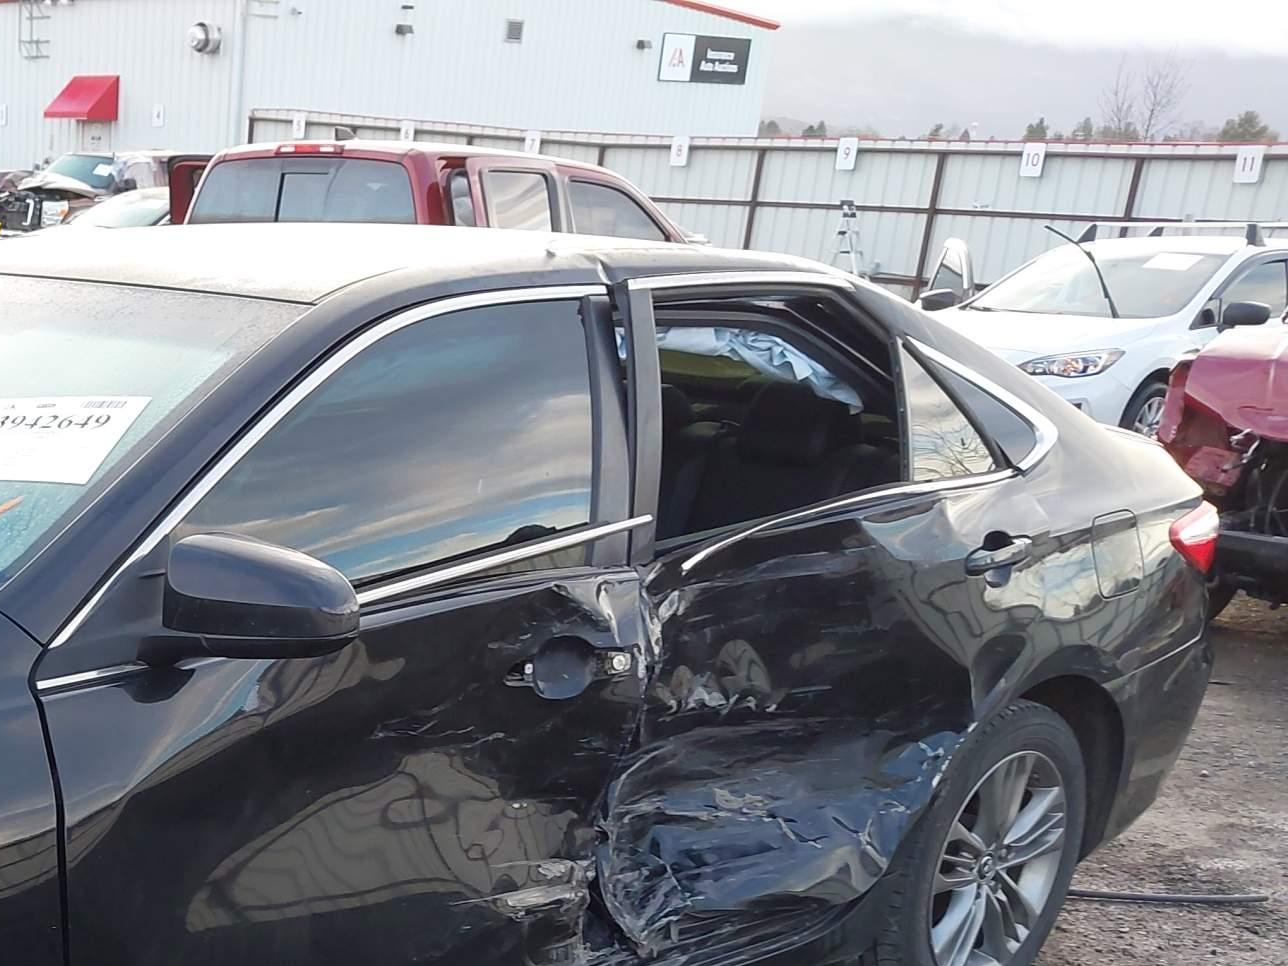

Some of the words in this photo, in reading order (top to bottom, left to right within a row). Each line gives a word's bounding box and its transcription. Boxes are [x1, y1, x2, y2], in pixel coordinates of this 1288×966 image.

[843, 146, 851, 160] 9
[1025, 152, 1040, 167] 10
[1242, 156, 1255, 172] 11
